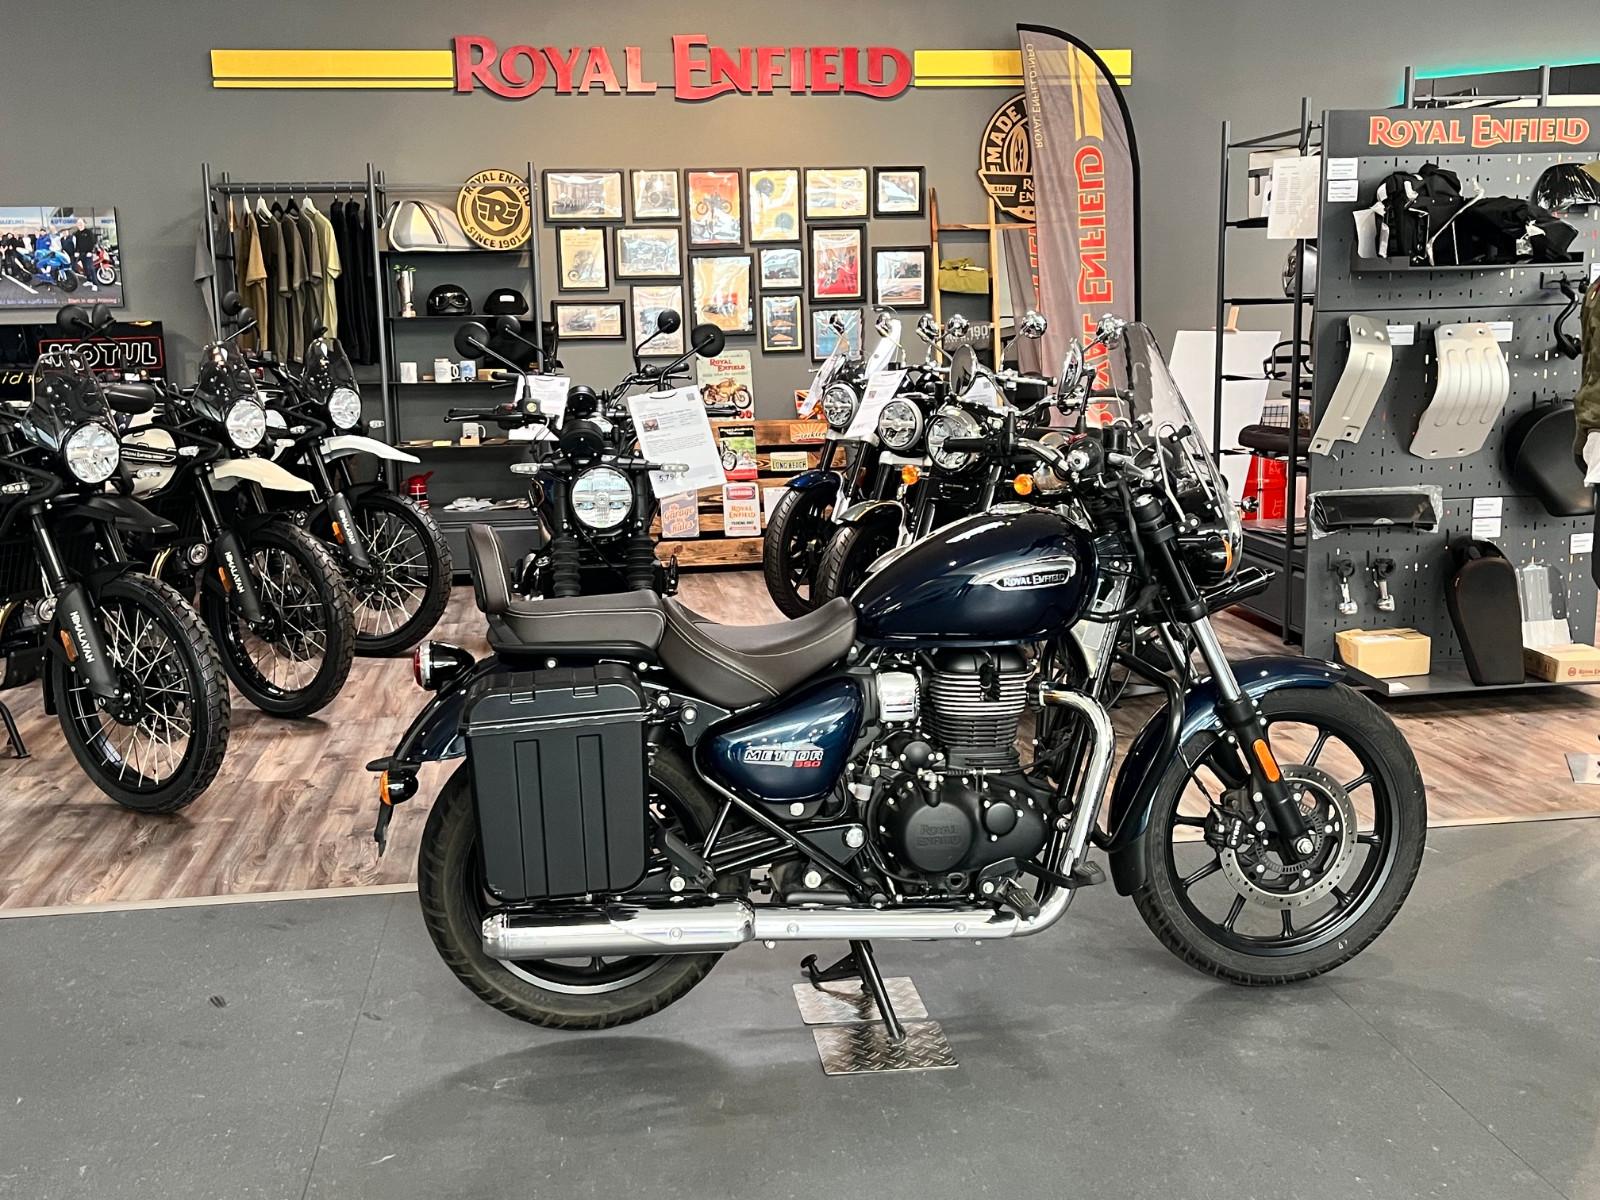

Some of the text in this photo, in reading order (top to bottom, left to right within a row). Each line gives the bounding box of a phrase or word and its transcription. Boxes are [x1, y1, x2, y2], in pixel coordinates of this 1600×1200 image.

[454, 34, 912, 99] ROYAL ENFIELD
[986, 105, 1021, 163] MADE
[1368, 114, 1590, 148] ROYAL ENFIELD
[464, 172, 496, 195] ROYAL
[993, 185, 1014, 193] SINCE
[467, 226, 521, 249] SINCE 1901
[48, 342, 157, 370] MOTUL
[709, 358, 732, 367] ROYAL
[224, 551, 246, 594] HIMALAYAN
[1003, 572, 1065, 587] ROYAL ENFIELD
[69, 610, 96, 663] HIMALAYAN
[743, 749, 824, 761] METEOR
[793, 760, 821, 768] 350
